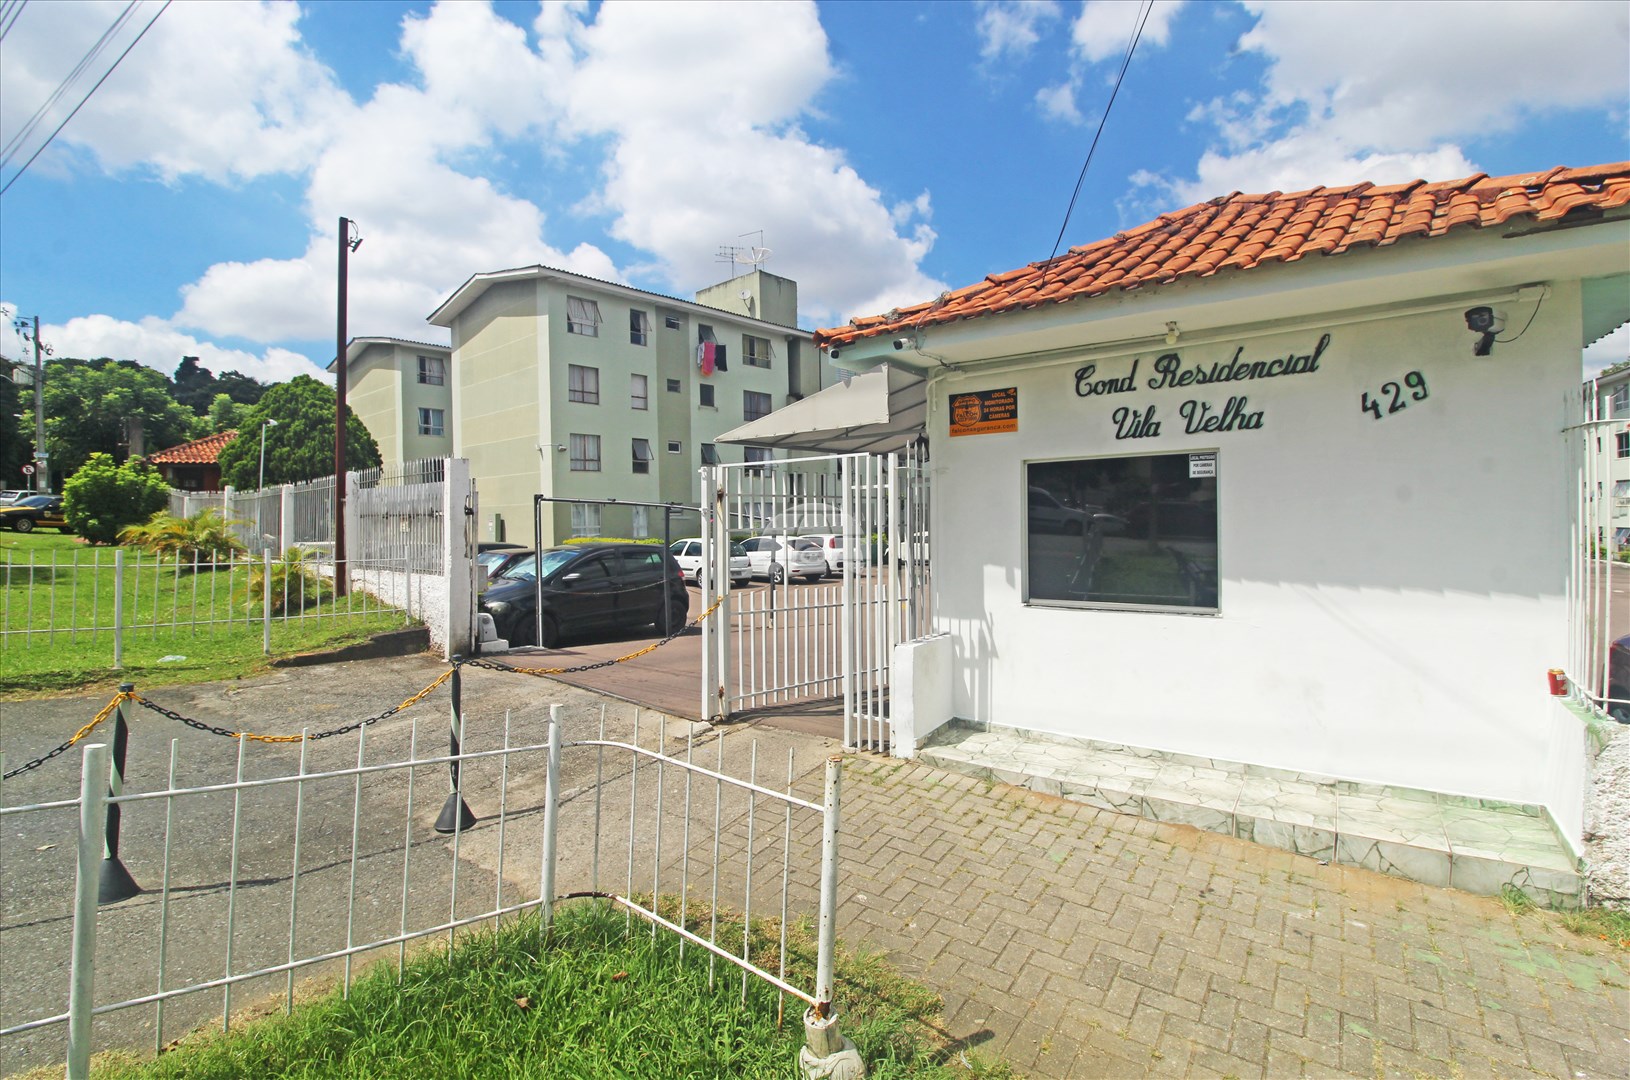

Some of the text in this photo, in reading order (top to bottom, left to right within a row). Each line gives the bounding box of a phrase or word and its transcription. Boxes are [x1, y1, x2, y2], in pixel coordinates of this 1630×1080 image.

[1074, 333, 1331, 398] Cond Residencial
[1112, 396, 1265, 440] Vila Velha
[1361, 371, 1429, 420] 429
